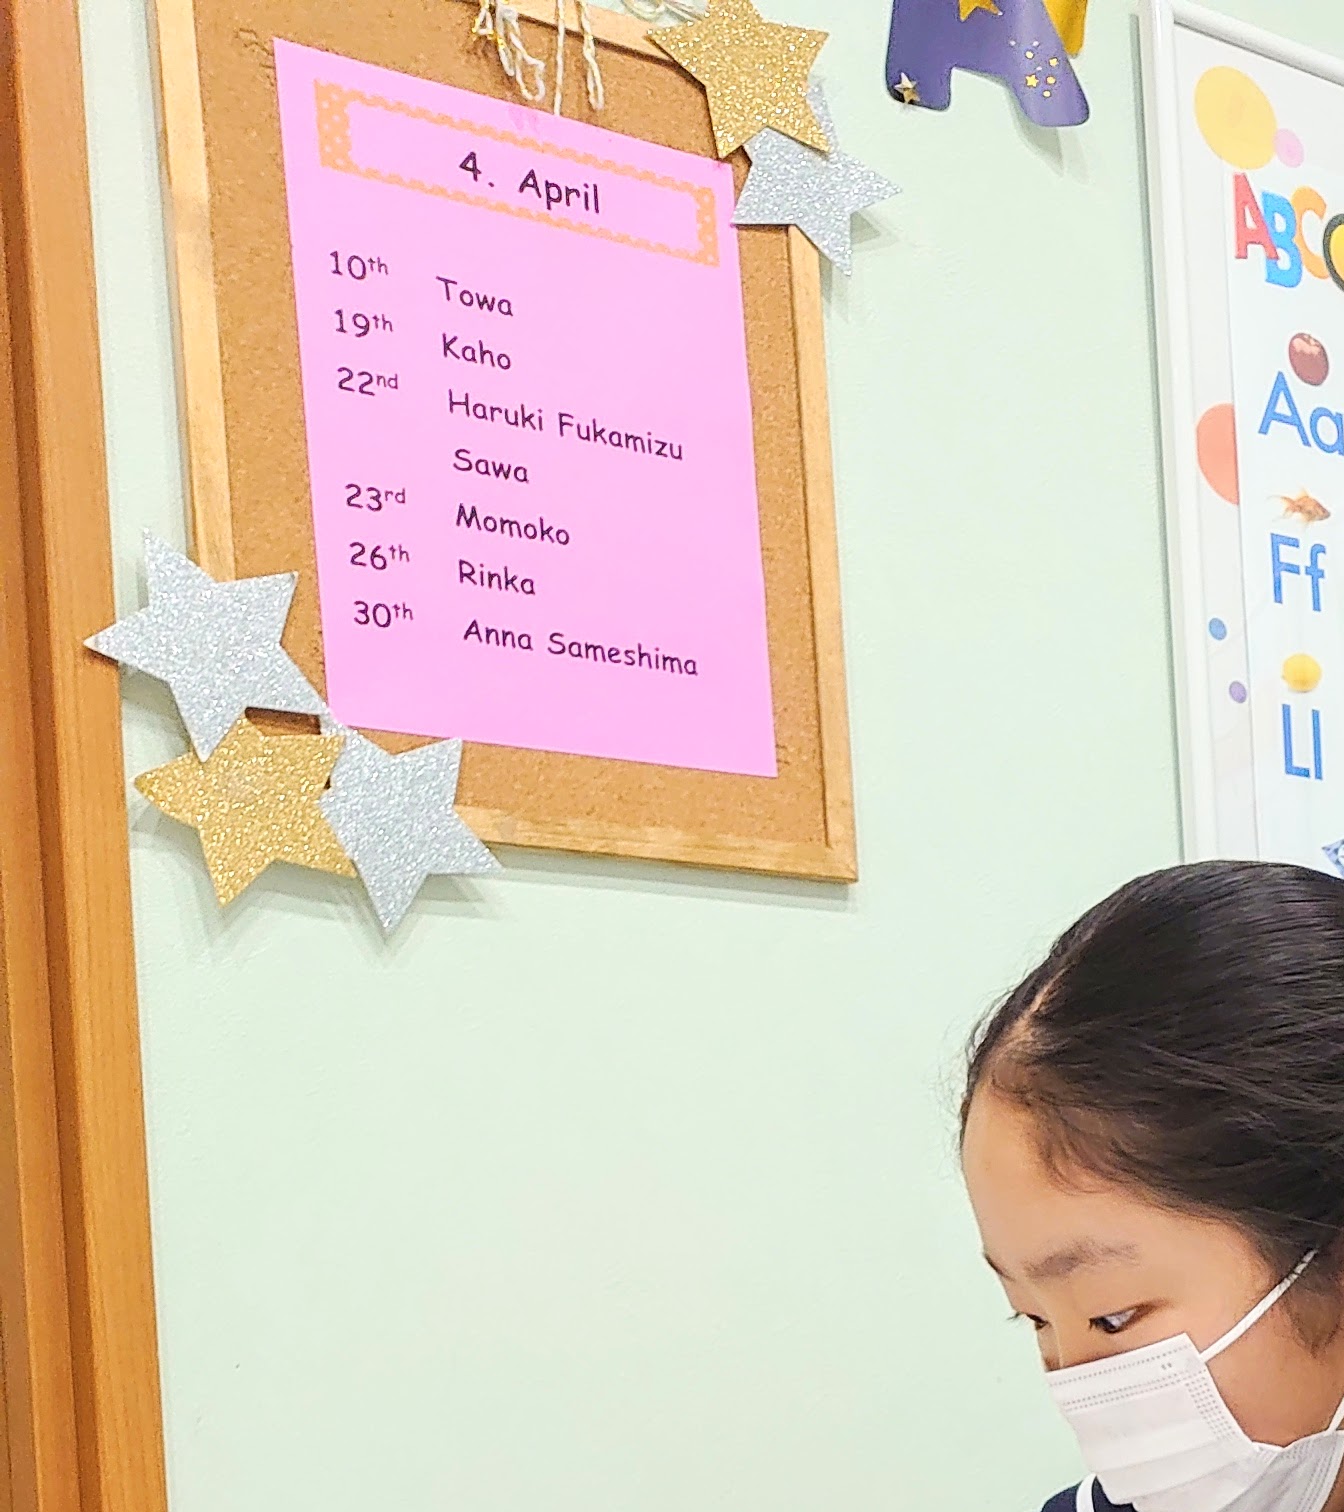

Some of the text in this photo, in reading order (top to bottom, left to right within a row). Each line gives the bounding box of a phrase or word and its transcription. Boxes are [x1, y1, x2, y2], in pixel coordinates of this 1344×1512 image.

[459, 152, 599, 218] 4. April
[1232, 172, 1330, 288] ABC
[330, 251, 513, 316] 10th Towa
[335, 309, 511, 370] 19th Kaho
[337, 367, 682, 460] 22nd Haruki Fukamizu
[1258, 368, 1344, 456] Aa
[453, 449, 529, 483] Sawa
[345, 483, 569, 545] 23rd Momoko
[349, 542, 535, 595] 26th Rinka
[1271, 533, 1326, 612] Ff
[354, 601, 698, 676] 30th Anna Sameshima
[1282, 704, 1322, 780] Ll
